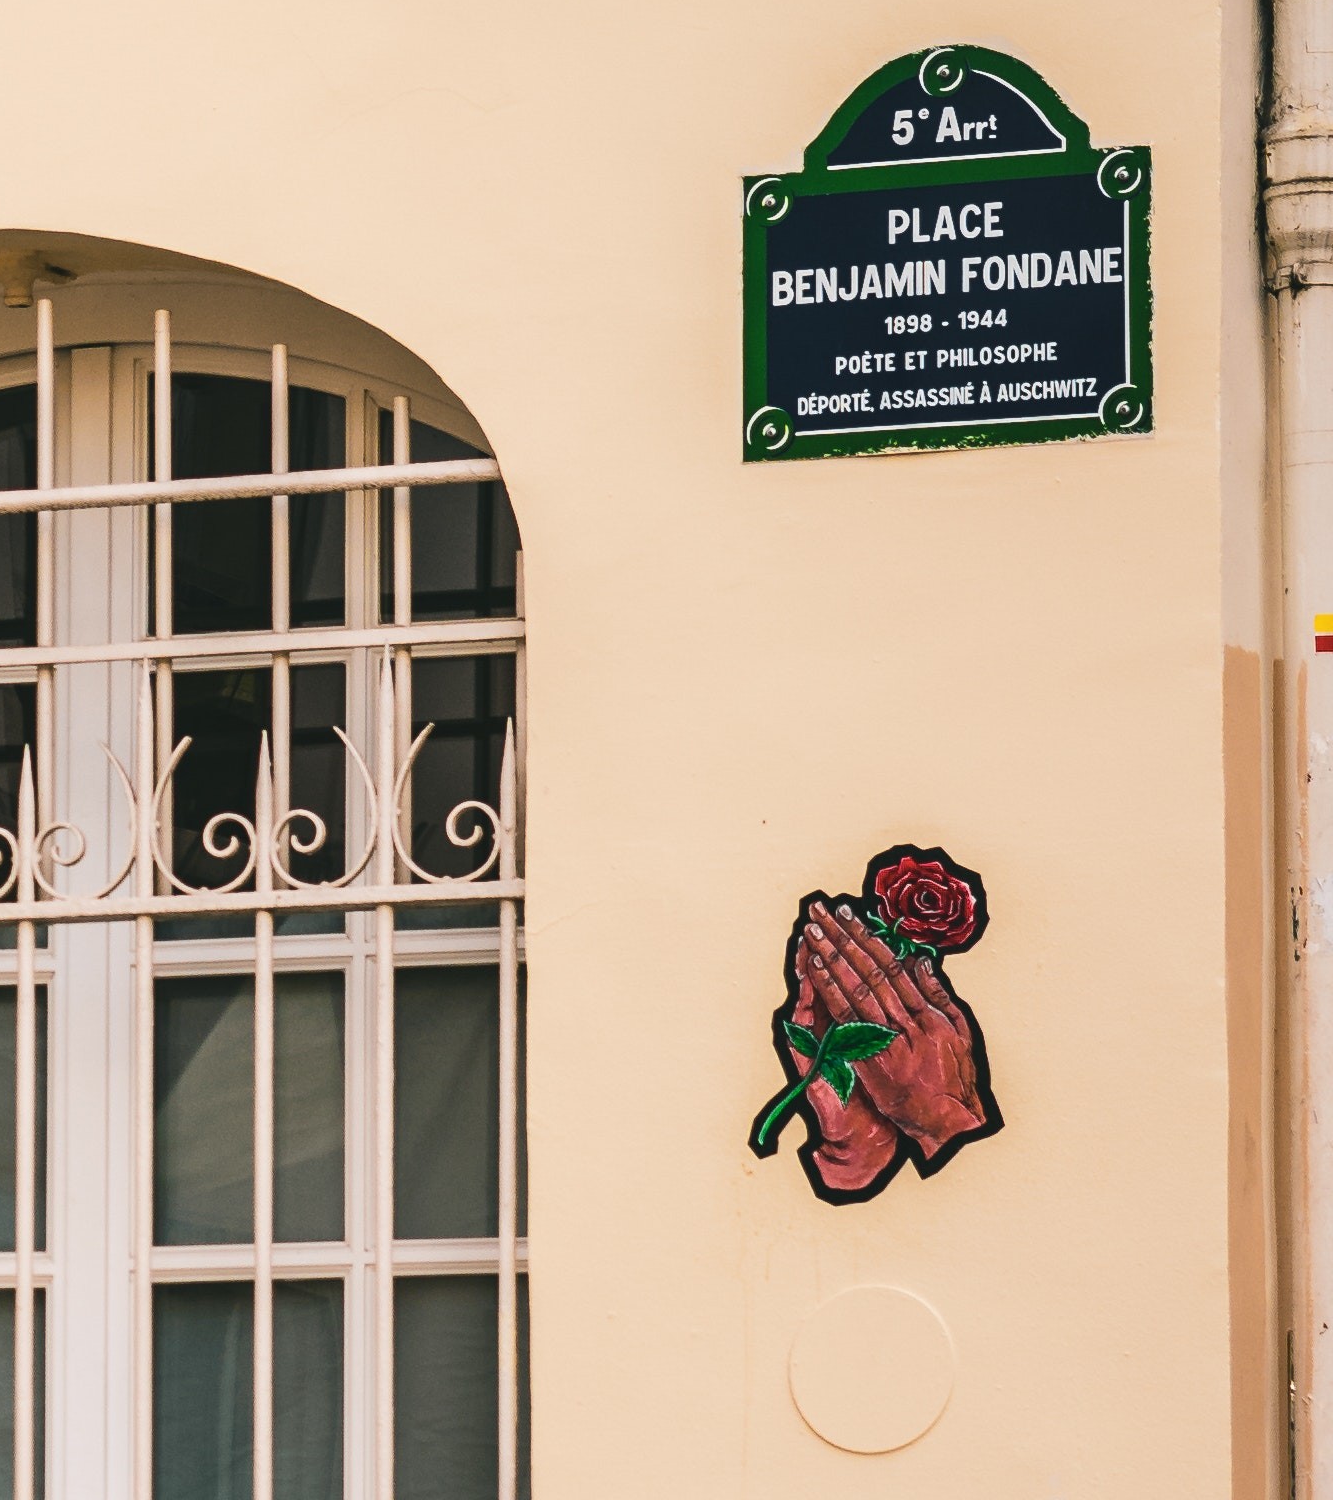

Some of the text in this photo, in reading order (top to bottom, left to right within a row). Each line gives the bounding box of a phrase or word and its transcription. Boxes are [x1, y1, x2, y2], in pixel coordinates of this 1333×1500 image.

[888, 201, 1004, 245] PLACE
[772, 246, 1123, 307] BENJAMIN FONDANE
[884, 313, 933, 336] 1898
[957, 308, 1008, 330] 1944
[835, 341, 1058, 375] POÈTE ET PHILOSOPHE
[797, 377, 1098, 416] DÉPORTÉ, ASSASSINÉ À AUSCHWITZ
